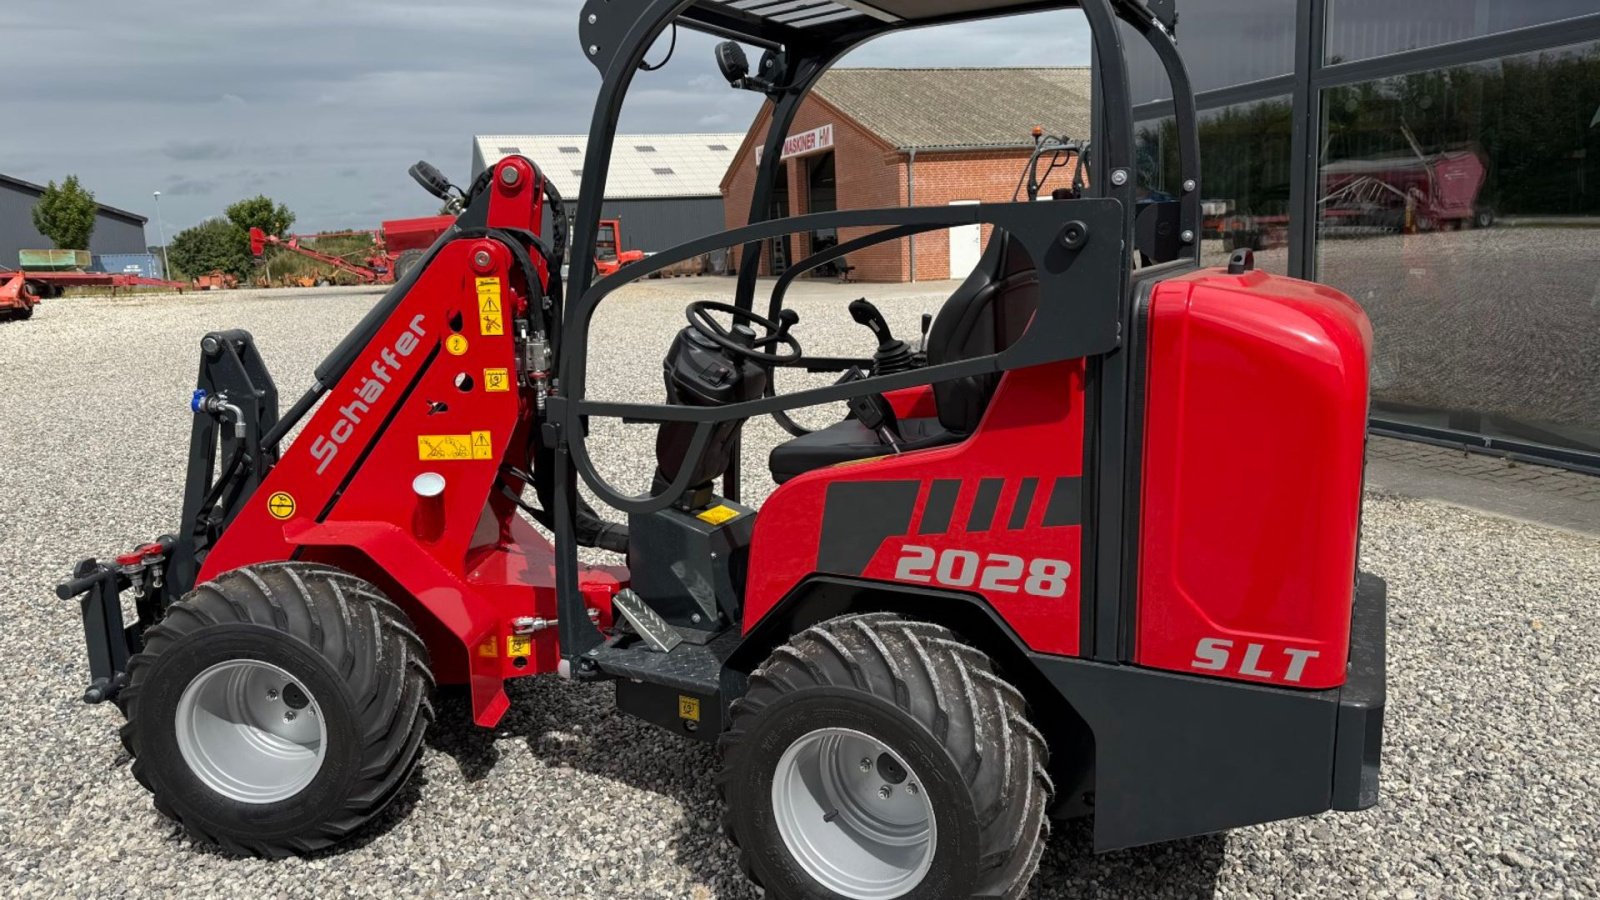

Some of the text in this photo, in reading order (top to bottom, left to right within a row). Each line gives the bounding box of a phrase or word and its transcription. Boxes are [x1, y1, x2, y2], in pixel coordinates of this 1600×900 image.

[784, 132, 815, 154] MASKINER
[310, 314, 426, 476] Schäffer
[894, 544, 1072, 598] 2028
[1191, 637, 1320, 682] SLT
